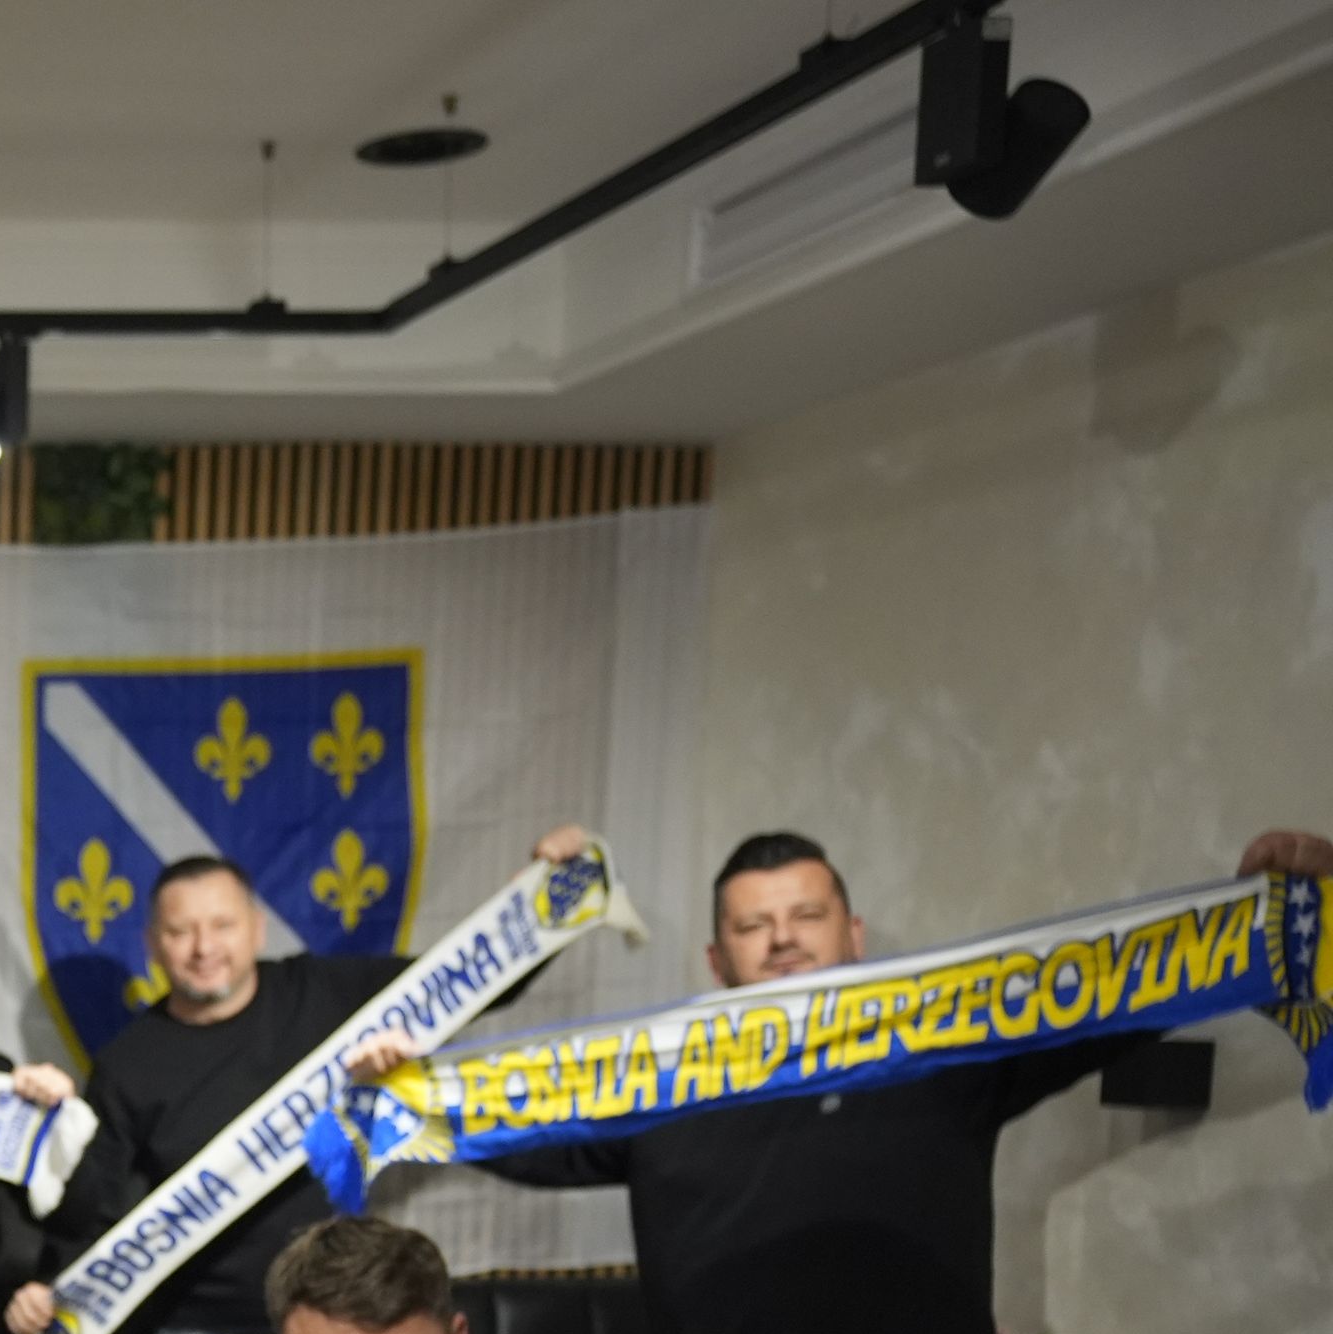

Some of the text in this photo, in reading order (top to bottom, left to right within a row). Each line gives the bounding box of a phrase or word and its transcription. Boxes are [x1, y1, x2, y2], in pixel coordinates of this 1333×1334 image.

[85, 1169, 239, 1294] BOSNIA
[236, 932, 503, 1173] HERZOVINA
[459, 893, 1259, 1136] BOSNIA AND HERZEGOVINA
